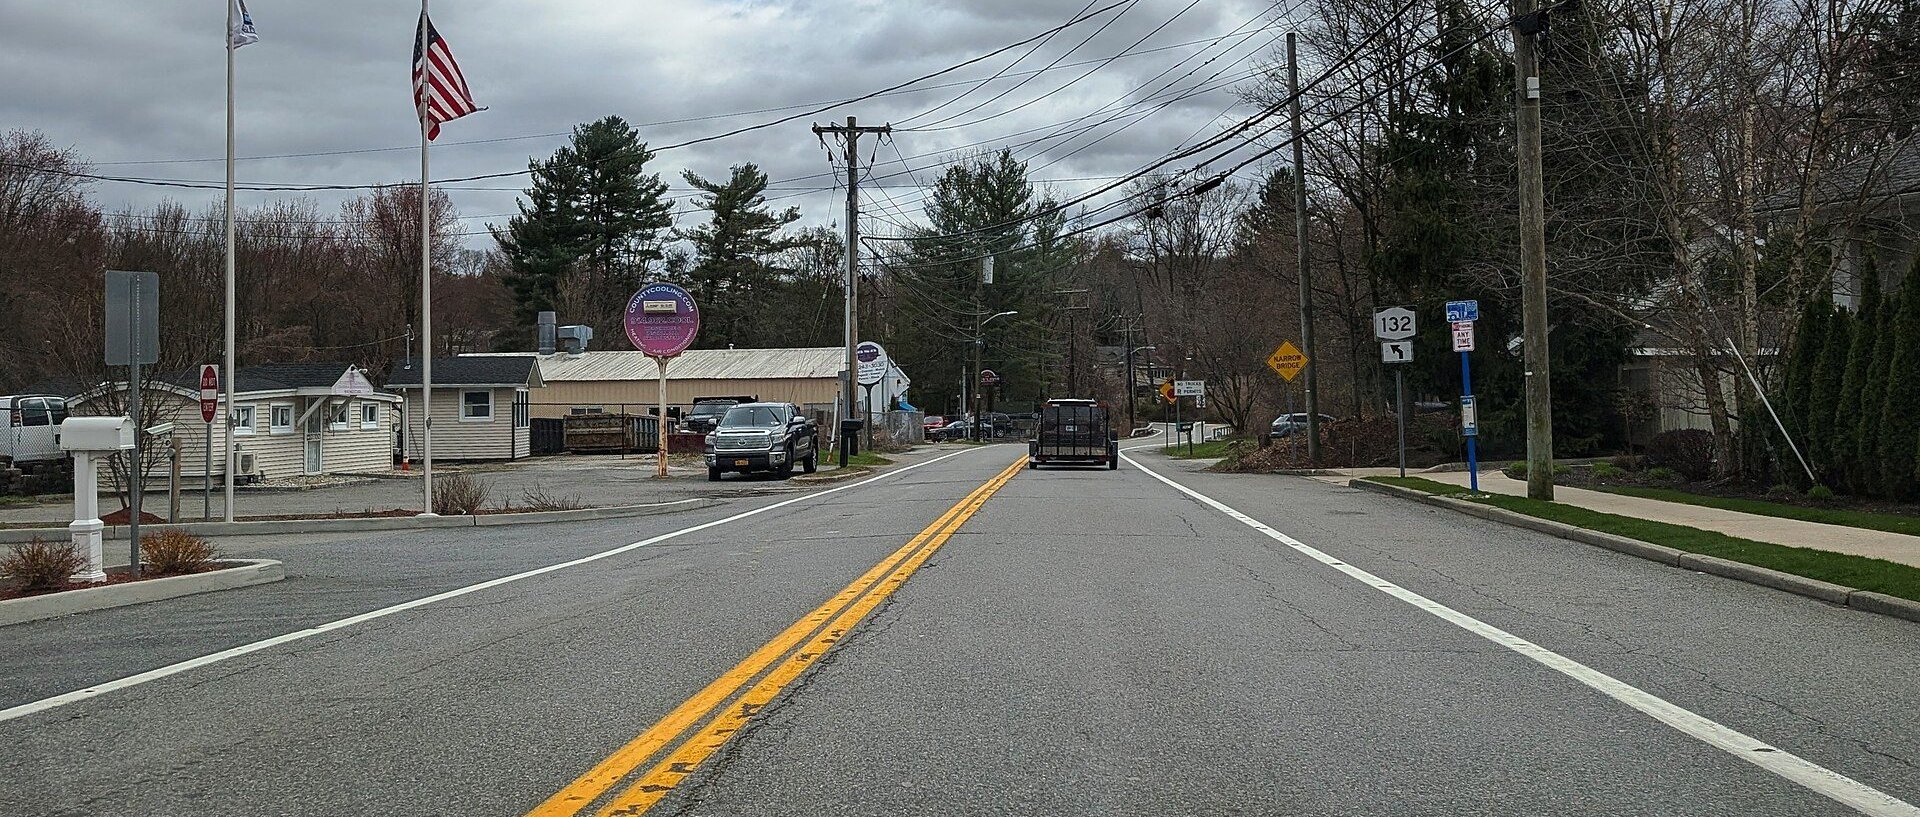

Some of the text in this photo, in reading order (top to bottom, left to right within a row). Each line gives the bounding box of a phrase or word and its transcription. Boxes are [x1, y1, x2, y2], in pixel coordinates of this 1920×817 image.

[629, 286, 694, 314] COUNTYCOOLING.COM
[1381, 316, 1412, 332] 132
[630, 328, 647, 349] HEATING
[662, 327, 694, 354] CONDITIONING
[1273, 354, 1302, 362] NARROW
[1276, 362, 1301, 370] BRIDGE
[203, 378, 207, 386] DO
[203, 403, 214, 411] ENTER
